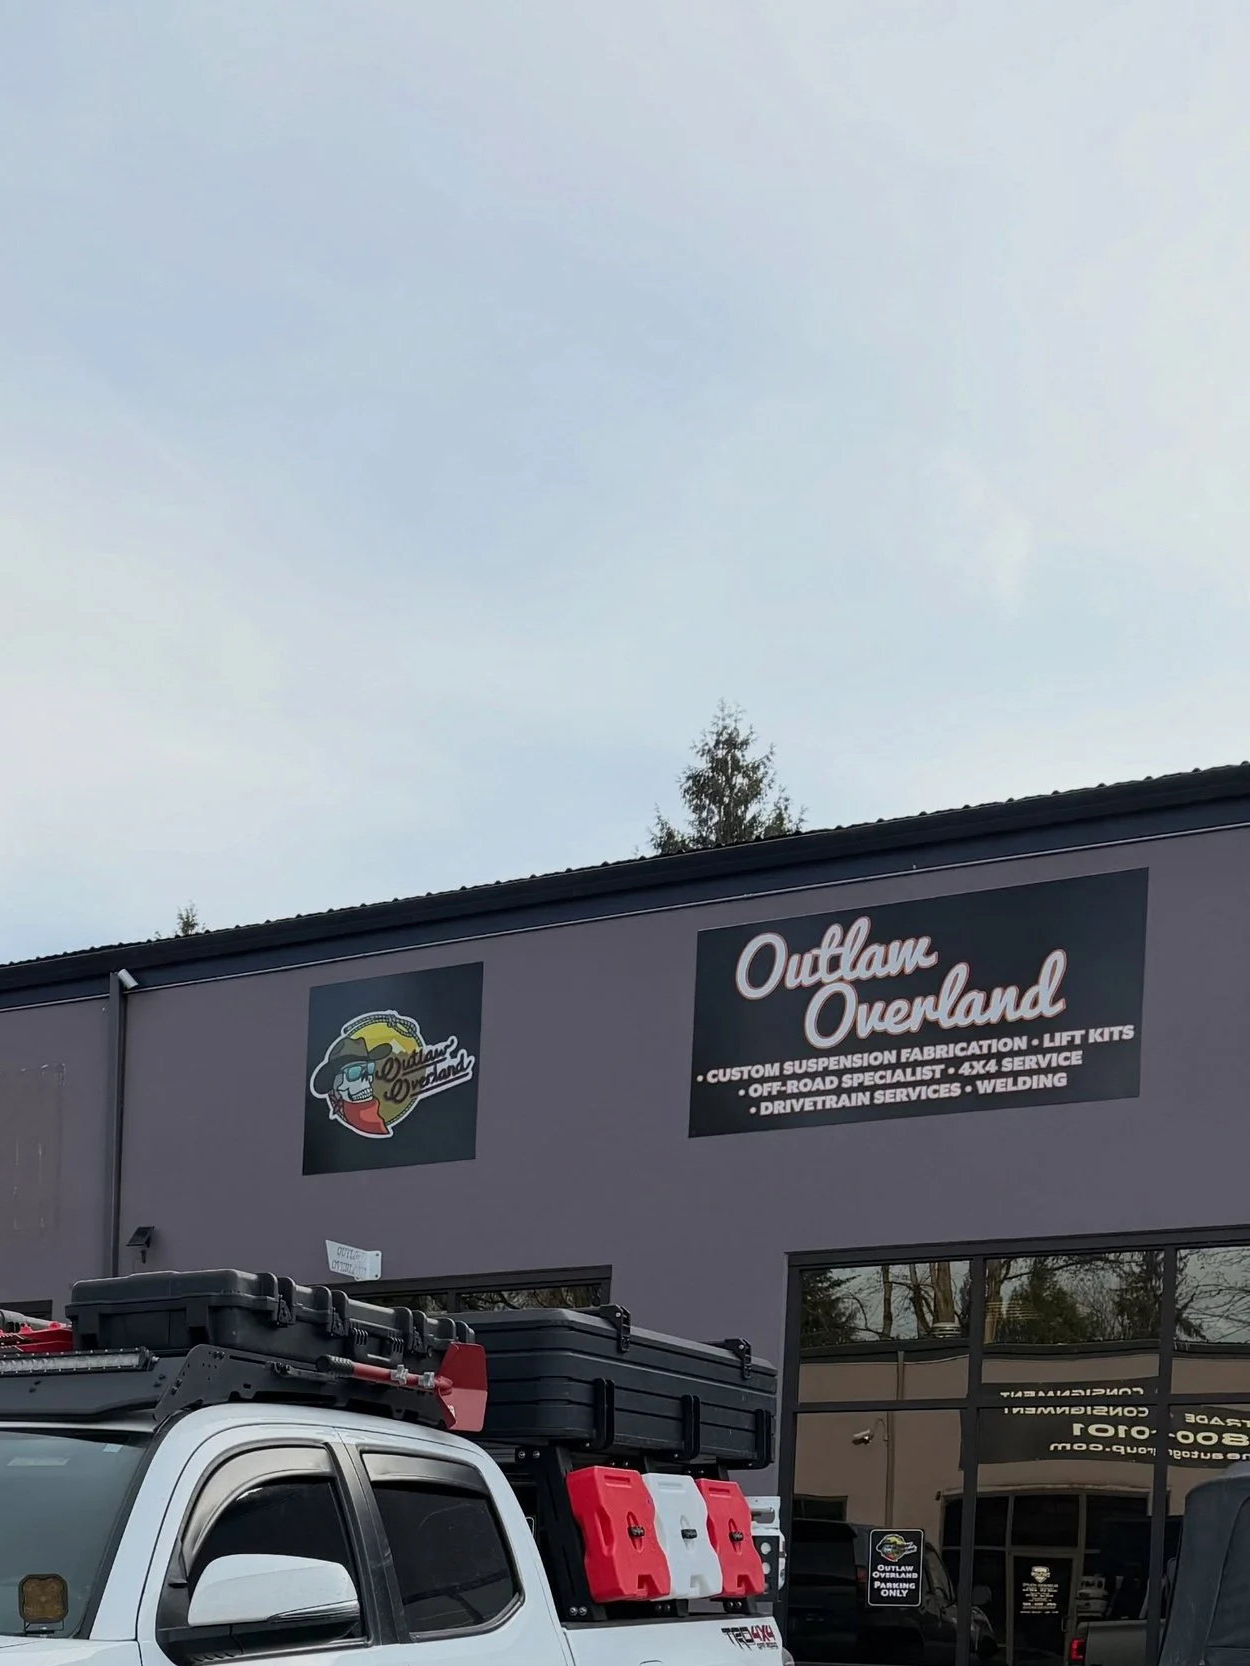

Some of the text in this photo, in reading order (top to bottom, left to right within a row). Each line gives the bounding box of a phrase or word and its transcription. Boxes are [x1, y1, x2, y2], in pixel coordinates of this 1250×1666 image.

[736, 915, 939, 1001] Outlaw
[803, 948, 1067, 1050] Overland
[375, 1045, 452, 1083] Outlaw
[706, 1024, 1135, 1084] CUSTOM SUSPENSION FABRICATION LIFT KITS
[747, 1050, 1083, 1098] OFF-ROAD SPECIALIST 4X4 SERVICE
[383, 1050, 472, 1104] Overland
[759, 1072, 1068, 1116] DRIVETRAIN SERVICES WELDING
[872, 1571, 919, 1579] OVERLAND
[874, 1580, 916, 1589] PARKING
[877, 1564, 914, 1572] OUTLAW
[880, 1589, 909, 1597] ONLY
